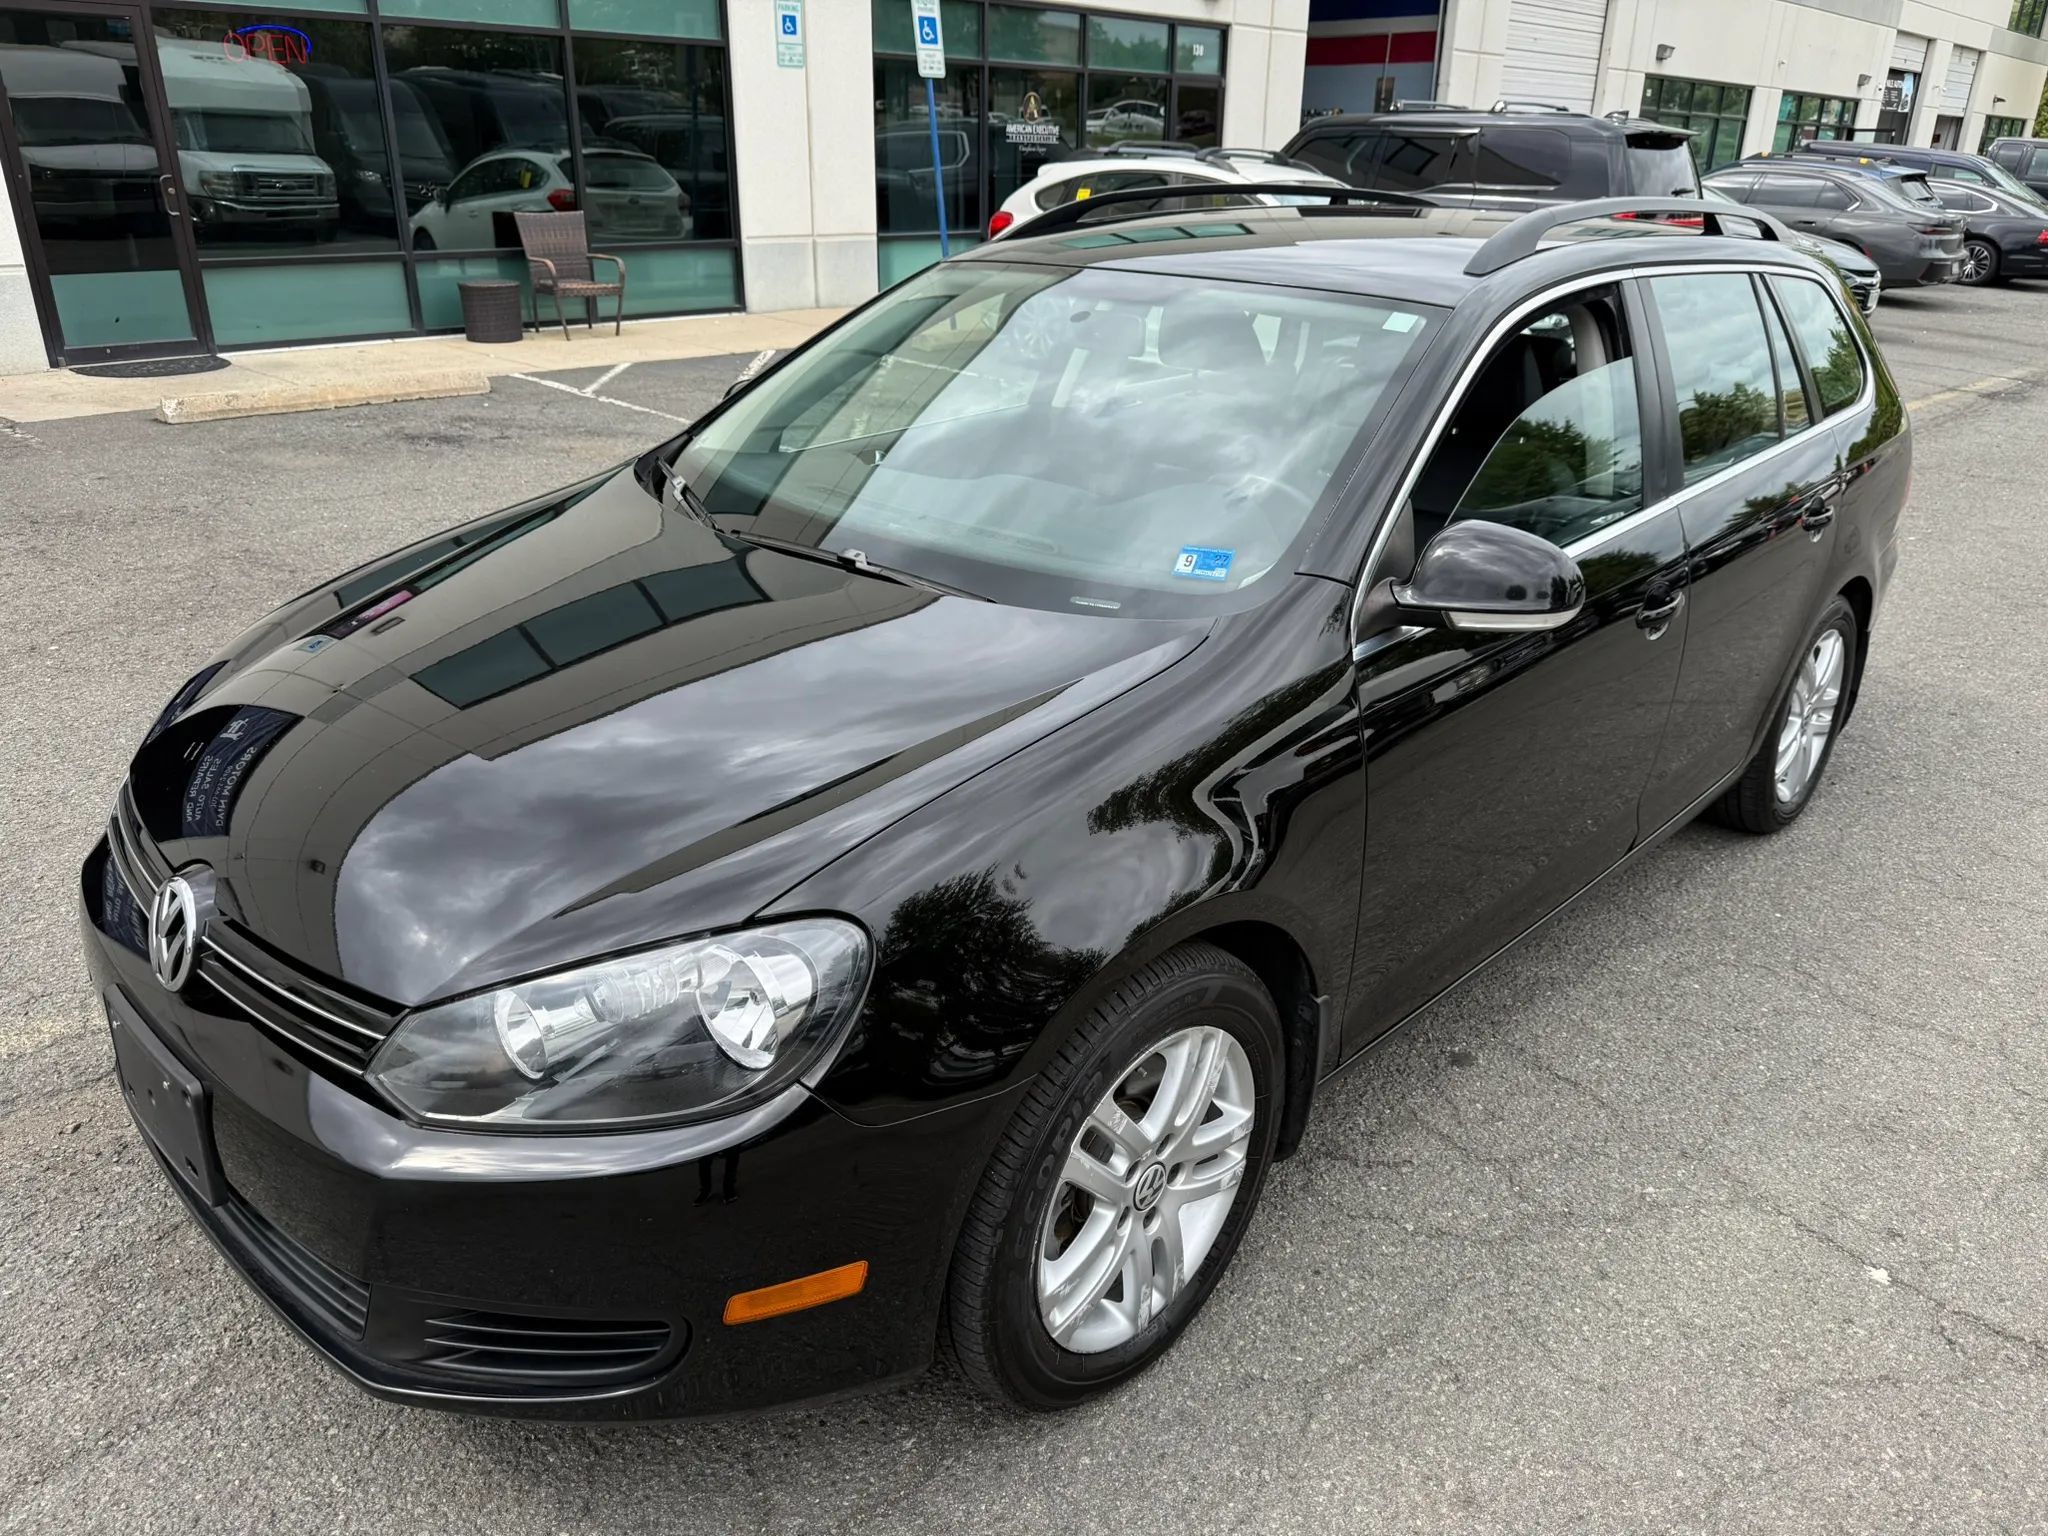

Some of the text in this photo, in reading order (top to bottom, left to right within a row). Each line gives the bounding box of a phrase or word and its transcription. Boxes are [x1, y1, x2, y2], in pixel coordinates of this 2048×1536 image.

[223, 32, 307, 64] OPEN
[1006, 124, 1032, 133] AMERICAN
[1183, 554, 1194, 568] 9
